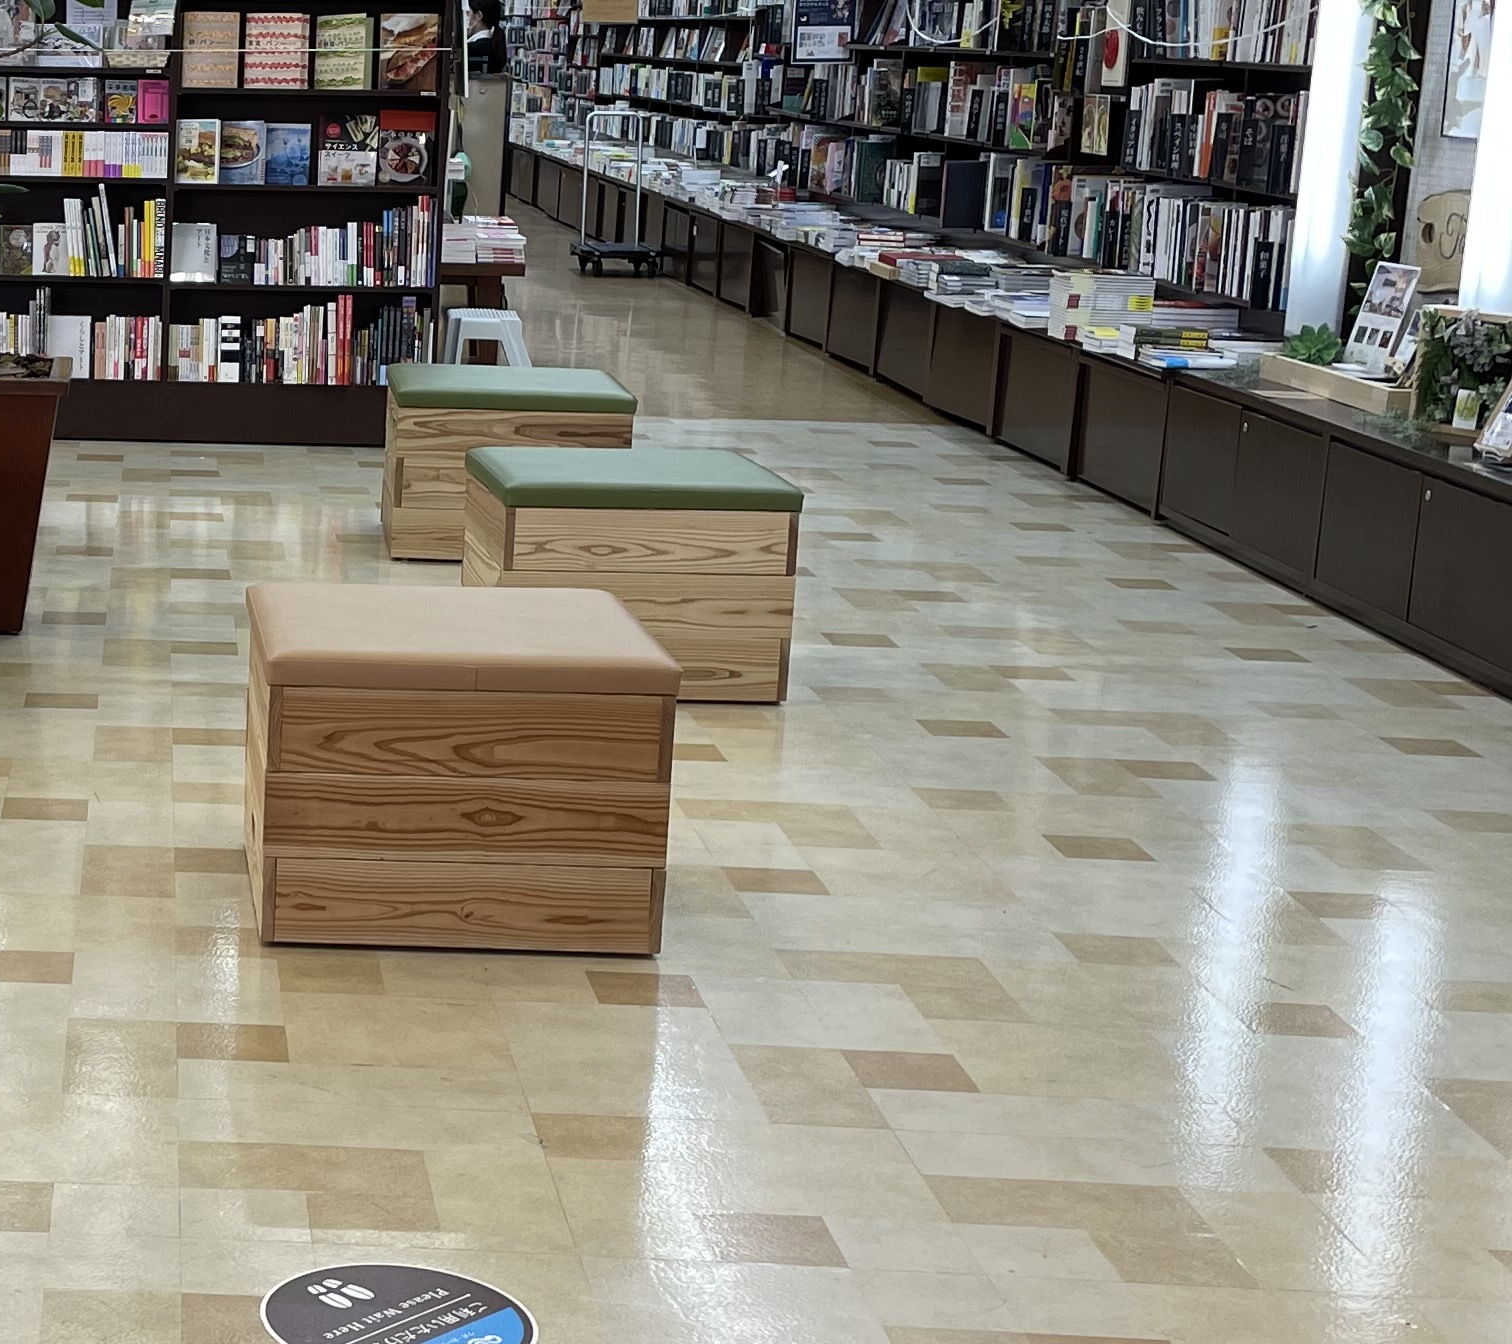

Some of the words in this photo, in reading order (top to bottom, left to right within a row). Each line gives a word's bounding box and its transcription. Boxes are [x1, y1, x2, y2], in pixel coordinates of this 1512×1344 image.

[324, 143, 359, 151] サイエンス
[398, 1287, 450, 1310] Please
[364, 1307, 403, 1326] Wait
[322, 1319, 365, 1340] Here
